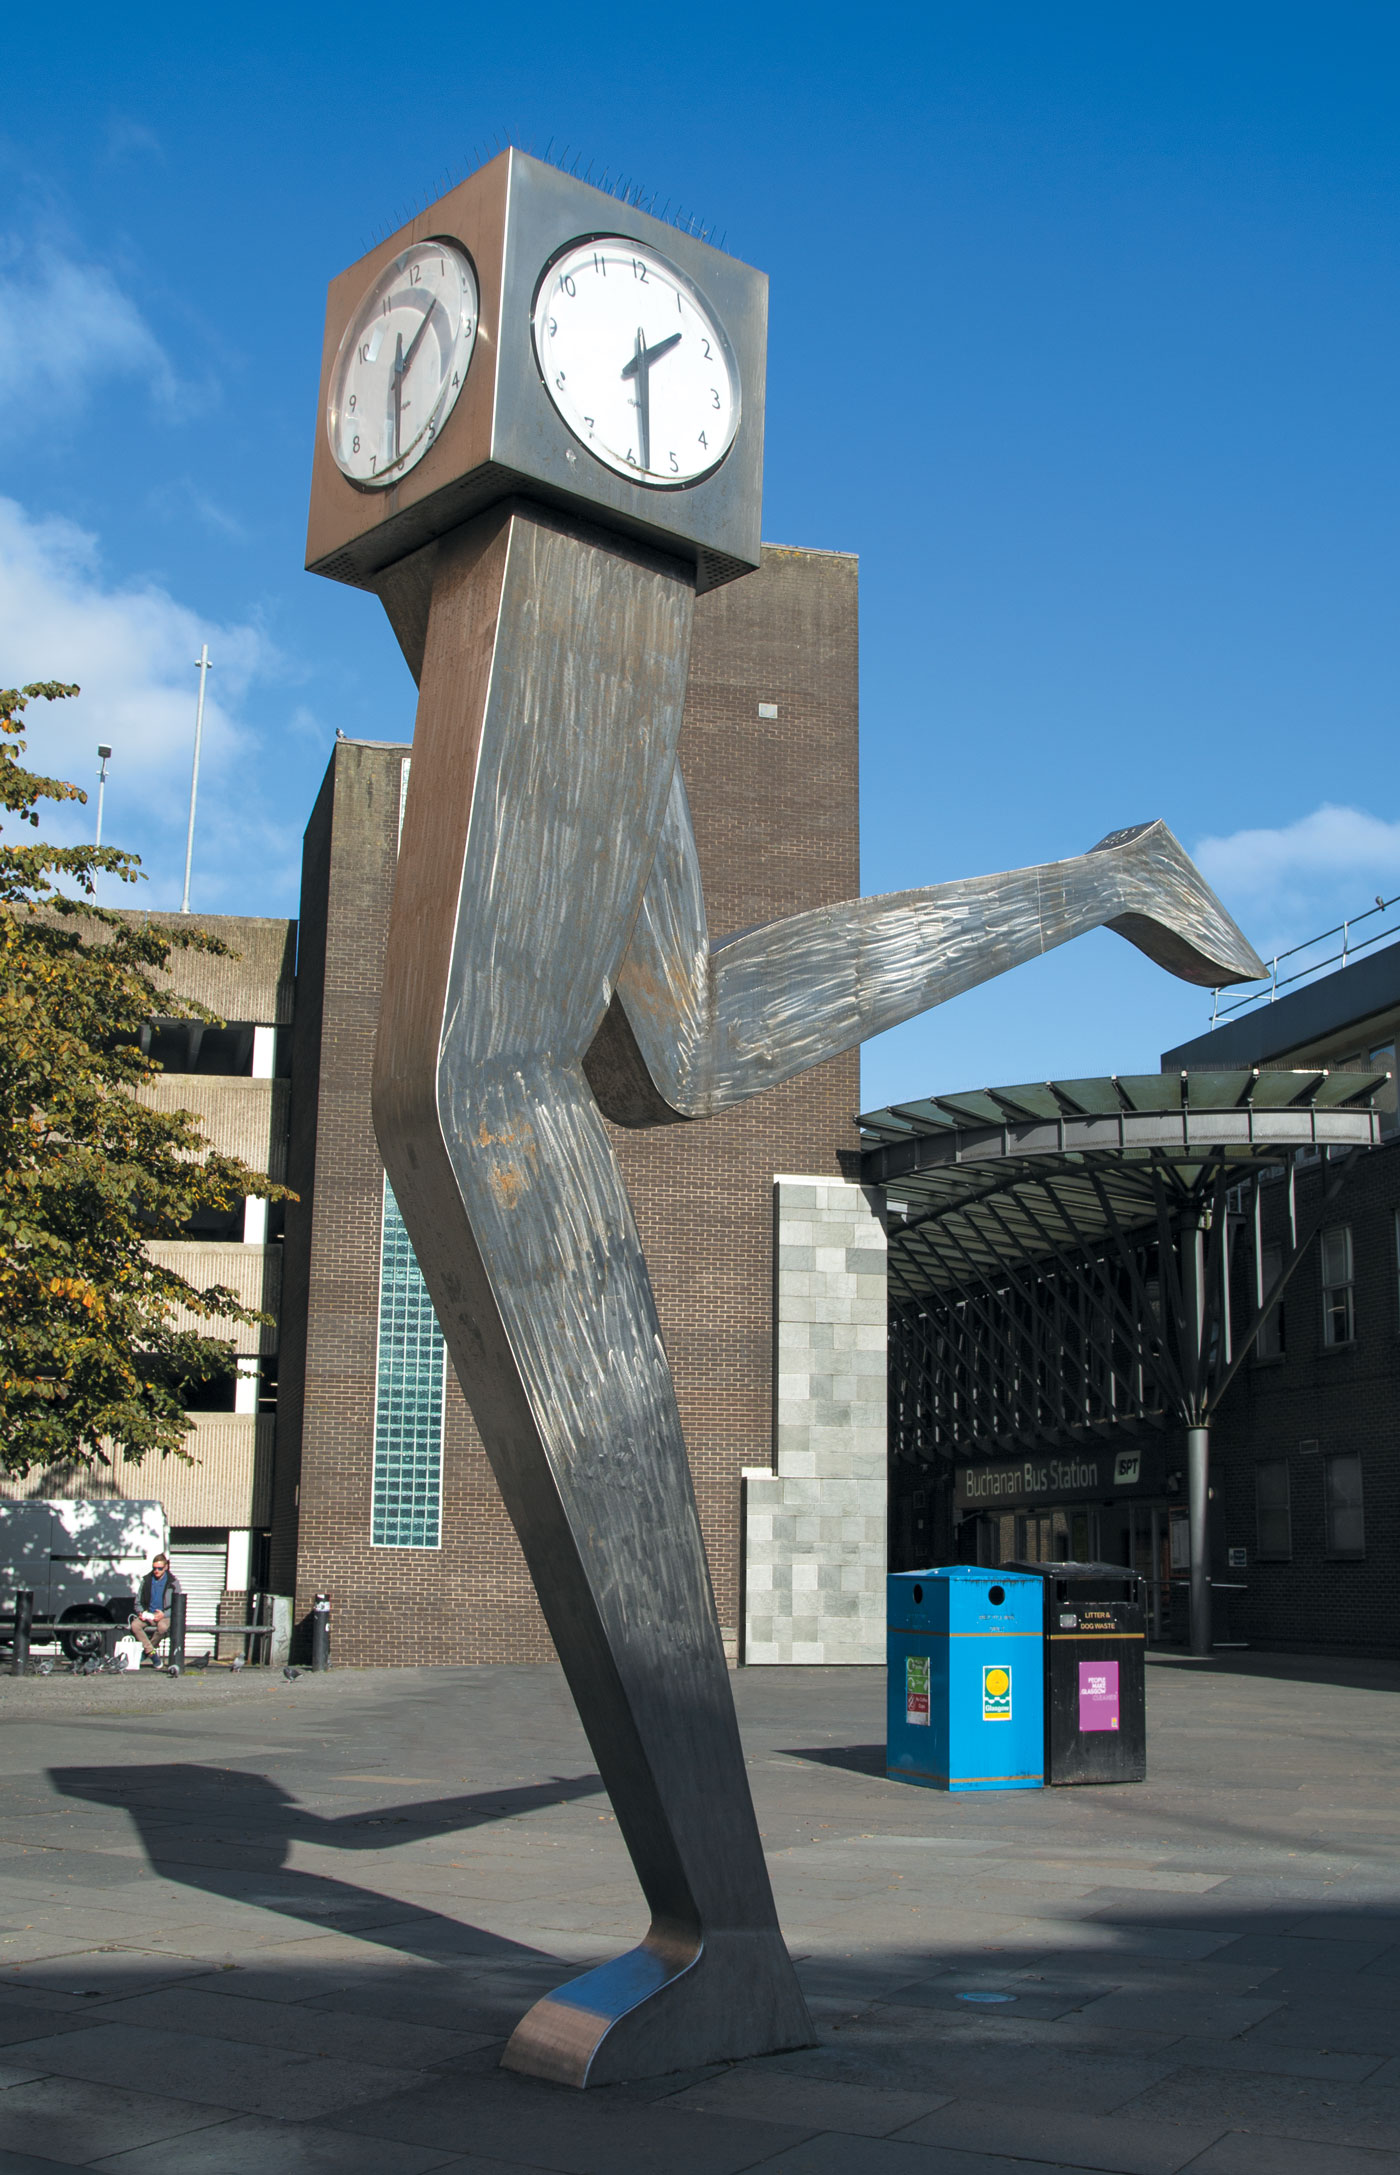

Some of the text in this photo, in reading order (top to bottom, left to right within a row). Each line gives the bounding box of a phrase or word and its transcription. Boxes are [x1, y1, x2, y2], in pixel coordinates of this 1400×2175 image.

[593, 253, 606, 277] 11
[632, 258, 649, 284] 12
[409, 265, 421, 286] 12
[559, 274, 576, 297] 10
[382, 296, 392, 317] 11
[676, 293, 682, 313] 1
[464, 319, 472, 338] 3
[358, 344, 370, 364] 10
[701, 338, 713, 360] 2
[452, 371, 460, 389] 4
[349, 394, 357, 413] 9
[710, 388, 721, 409] 3
[353, 436, 361, 453] 8
[697, 430, 709, 450] 4
[369, 455, 377, 474] 7
[669, 451, 679, 473] 5
[966, 1456, 1098, 1498] Buchanan Bus Station
[1119, 1458, 1138, 1476] SPT
[1094, 1622, 1116, 1630] WASTE
[985, 1704, 1009, 1712] Glasgow
